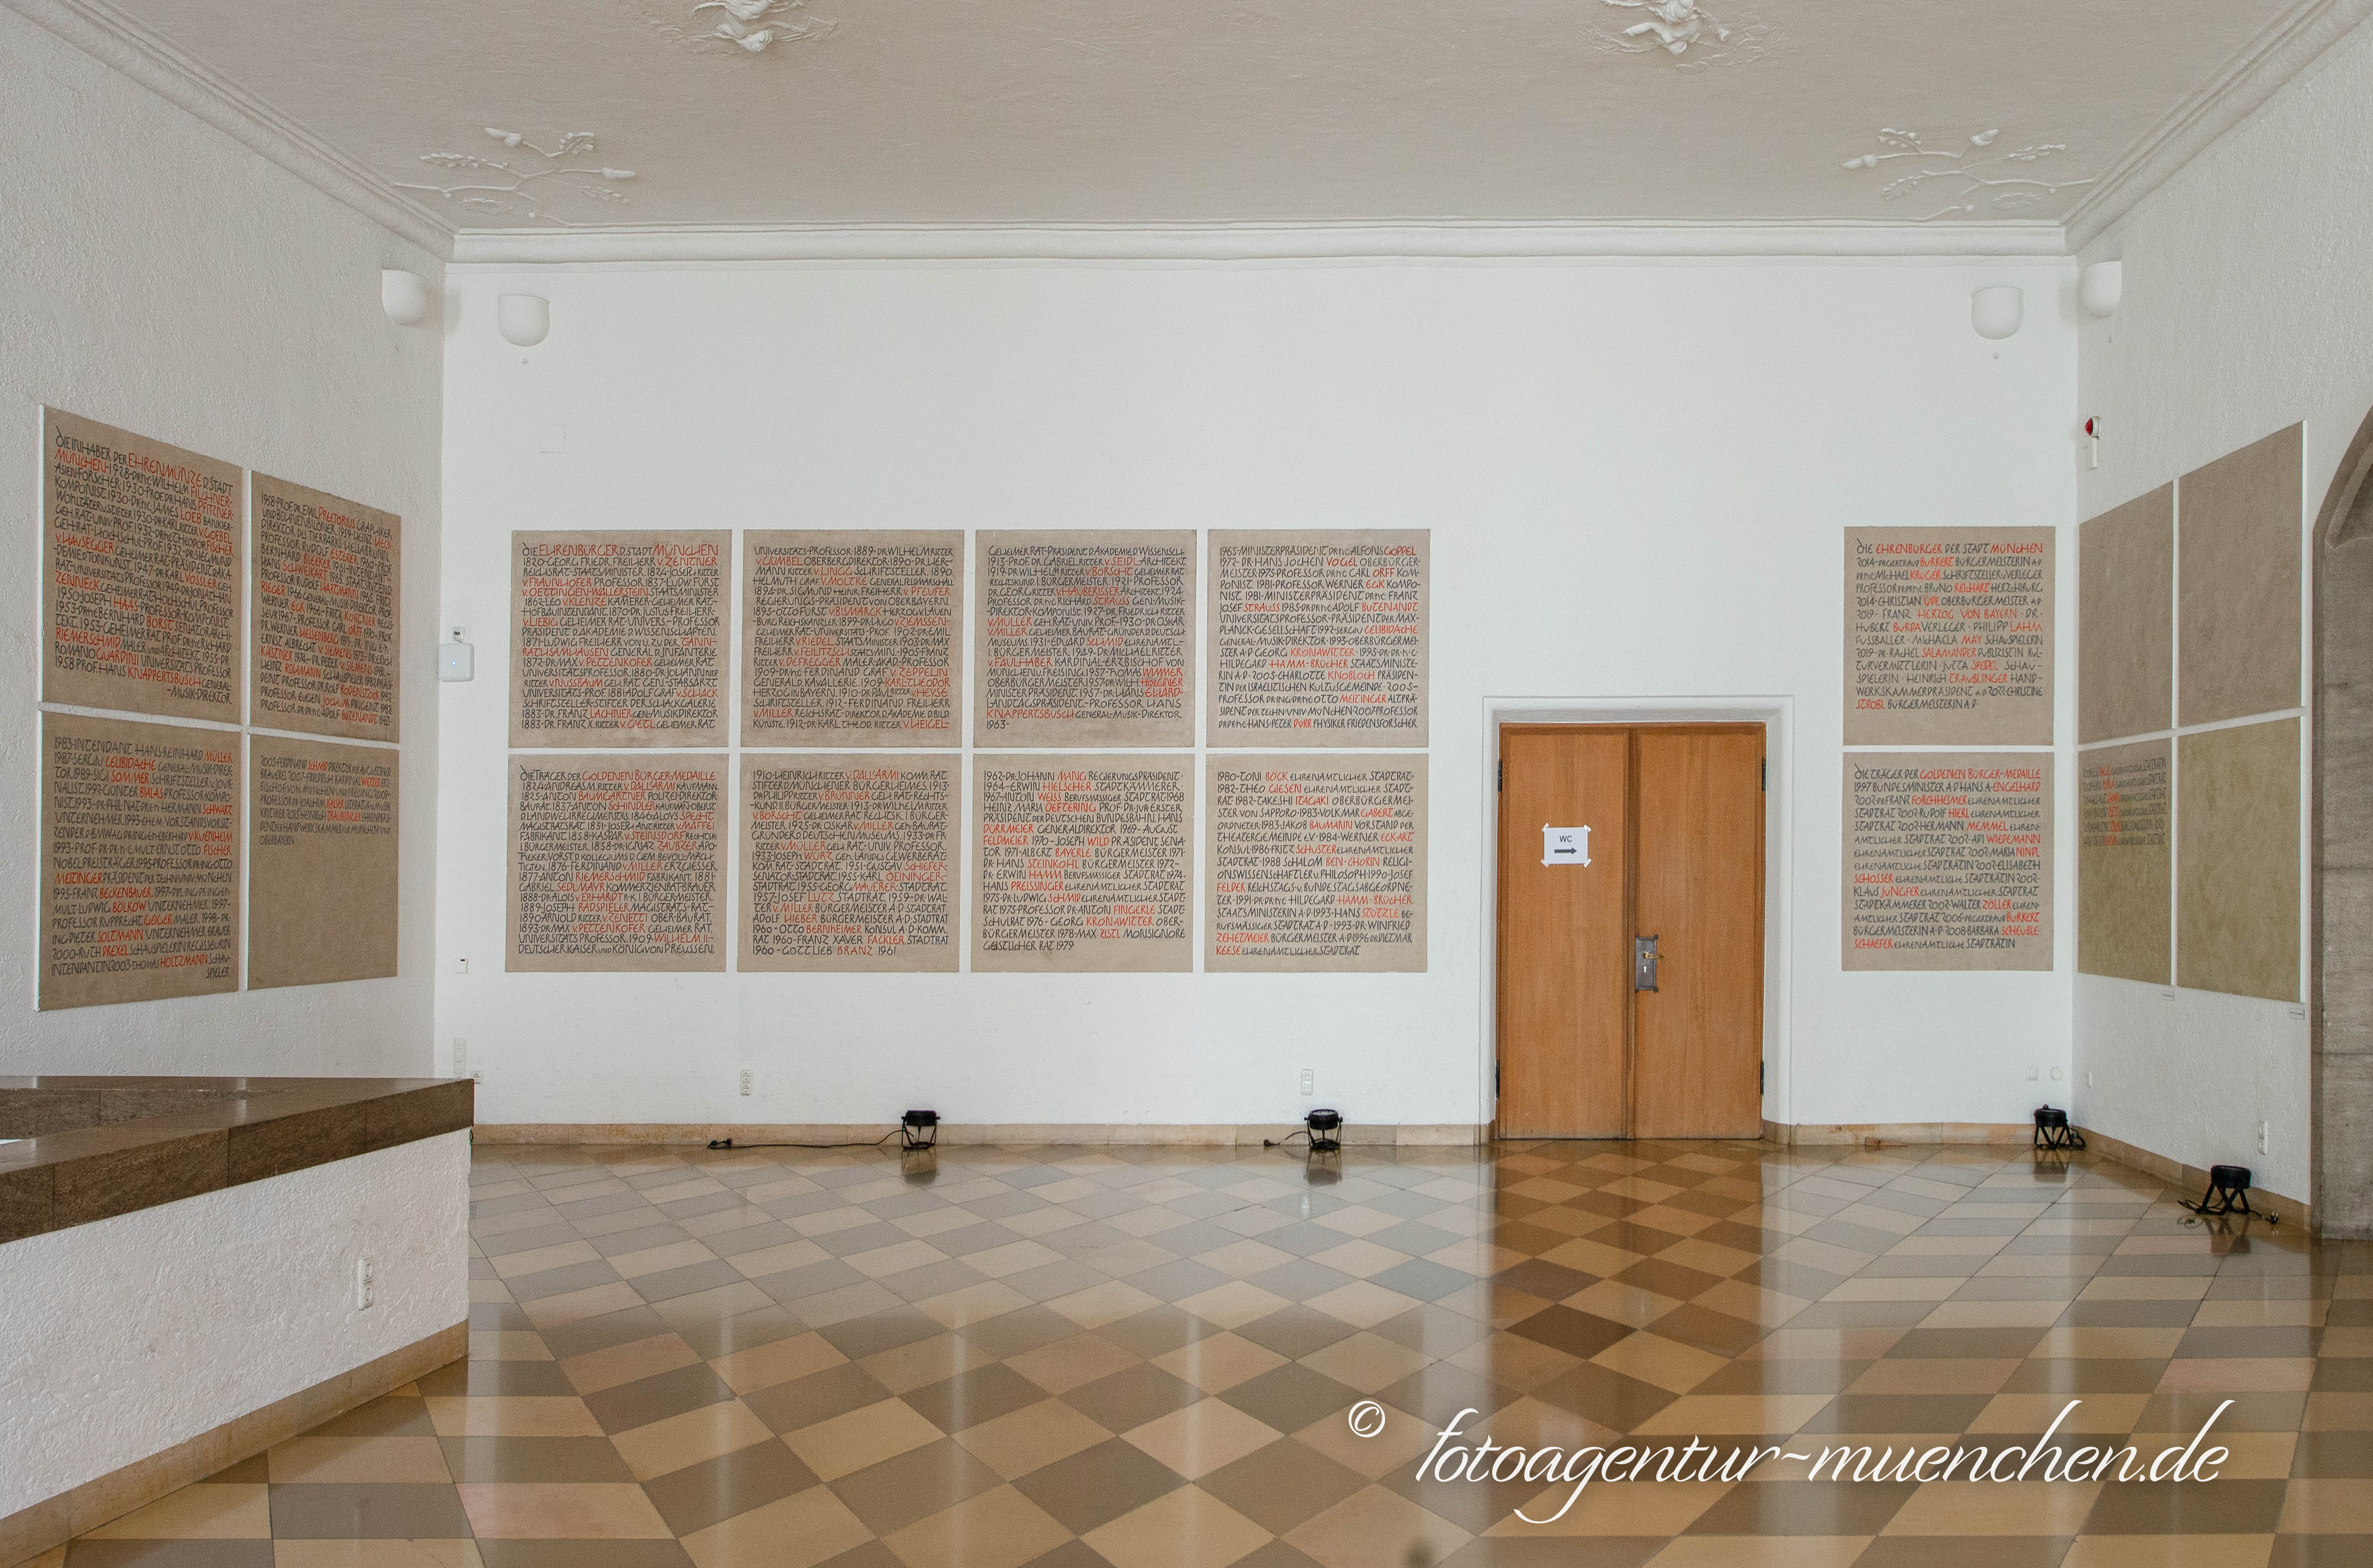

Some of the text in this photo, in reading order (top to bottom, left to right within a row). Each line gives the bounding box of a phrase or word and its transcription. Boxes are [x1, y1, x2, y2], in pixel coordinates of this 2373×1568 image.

[539, 543, 618, 556] EHRENBÜRGER
[652, 543, 718, 556] MÜNCHEN
[1876, 544, 1942, 553] EHRENBÜRGER
[1945, 544, 1960, 553] DER
[1962, 543, 1990, 553] STADT
[1991, 543, 2043, 553] MÜNCHEN
[1284, 557, 1357, 566] JOCHEN VOGEL
[1921, 557, 1954, 566] BURKERT
[932, 567, 952, 576] 1890
[1349, 569, 1394, 577] CARL ORFF
[754, 577, 953, 586] HELMUTH GRAF GENERALFELDMARSCHALL
[1326, 579, 1364, 588] WERNER
[1924, 583, 1990, 592] BRUNO REICHART
[1092, 597, 1130, 606] STRAUSS
[1924, 596, 2028, 606] UDE OBERBÜRGERMEISTER
[800, 607, 827, 616] FÜRST
[1243, 603, 1419, 612] STRAUSS BUTENANDT
[1918, 609, 2016, 618] HERZOG BAYERN
[673, 618, 719, 626] PROFESSOR
[1157, 618, 1184, 626] OSKAR
[1856, 622, 2042, 631] HUBERT PHILIPP LAHM
[522, 627, 571, 636] PRÄSIDENT
[1365, 625, 1418, 634] CELIBIDACHE
[1087, 637, 1123, 646] SCHMID
[1856, 635, 1982, 644] FUSSBALLER MAY
[611, 648, 653, 656] GENERAL
[1291, 648, 1355, 657] KRONAWITTER
[1922, 648, 1975, 657] SALAMANDER
[1220, 659, 1266, 668] HILDEGARD
[805, 667, 887, 677] FERDINAND GRAF
[1143, 668, 1183, 677] WIMMER
[1328, 672, 1374, 680] KNOBLOCH
[1949, 674, 2007, 683] TRAUBLINGER
[1340, 695, 1386, 703] MEITINGER
[1856, 700, 1884, 709] STROBL
[591, 709, 632, 718] LACHNER
[987, 709, 1182, 718] KNAPPERTSBUSCH GENERAL-MUSIK-DIREKTOR
[1313, 719, 1417, 729] PHYSIKER FRIEDENSFORSCHER
[582, 770, 715, 781] GOLDENEN BÜRGER-MEDAILLE
[1057, 771, 1086, 781] MANG
[1265, 771, 1288, 781] BÖCK
[1920, 769, 1965, 779] GOLDENEN
[1043, 782, 1091, 791] HIELSCHER
[1269, 784, 1301, 793] GIESEN
[578, 792, 645, 801] BAUMGARTNER
[1038, 792, 1061, 801] WEISS
[1295, 796, 1328, 805] ITAGAKI
[609, 802, 654, 810] SCHINDLER
[984, 803, 1096, 812] HEINZ OEFTERING
[1361, 809, 1393, 817] GABERT
[1948, 808, 1969, 818] HIERL
[1310, 820, 1352, 829] BAUMANN
[1966, 821, 2008, 831] MEMMEL
[984, 825, 1116, 834] DÜRRMEIER GENERALDIREKTOR
[984, 836, 1109, 845] FELDMEIER WILD
[1218, 833, 1414, 842] THEATERGEMEINDE ECKART
[1986, 835, 2040, 844] WIEDEMANN
[657, 841, 697, 850] ZAUBZER
[1296, 845, 1336, 854] SCHUSTER
[805, 852, 832, 860] WÜRZ
[1056, 848, 1091, 857] BAYERLE
[2016, 847, 2039, 856] NINDL
[1027, 859, 1079, 869] STEINKOHL
[576, 873, 645, 882] RIEMERSCHMID
[1854, 874, 1893, 884] SCHOSSER
[520, 882, 606, 891] GABRIEL SEDLMAYR
[1011, 882, 1063, 891] PREISSINGER
[1217, 883, 1244, 892] FELDER
[1881, 887, 1919, 898] JUNGFER
[808, 893, 835, 902] LUTZ
[578, 903, 629, 911] RADSPIELER
[815, 904, 887, 912] BÜRGERMEISTER
[1983, 900, 2011, 909] ZÖLLER
[1114, 905, 1155, 914] FINGERLE
[1362, 908, 1399, 917] STÜTZLE
[753, 914, 816, 923] ADOLF HIEBER
[807, 925, 896, 933] BERNHEIMER KONSUL
[1367, 921, 1410, 930] WINFRIED
[1123, 929, 1185, 938] MONSIGNORE
[1217, 933, 1269, 942] ZEHETMEIER
[832, 935, 904, 944] XAVER FACKLER
[1854, 939, 1892, 948] SCHAEFER
[519, 944, 566, 954] DEUTSCHER
[1057, 941, 1074, 950] 1979
[837, 946, 896, 955] BRANZ 1961
[1217, 946, 1240, 955] KEESE
